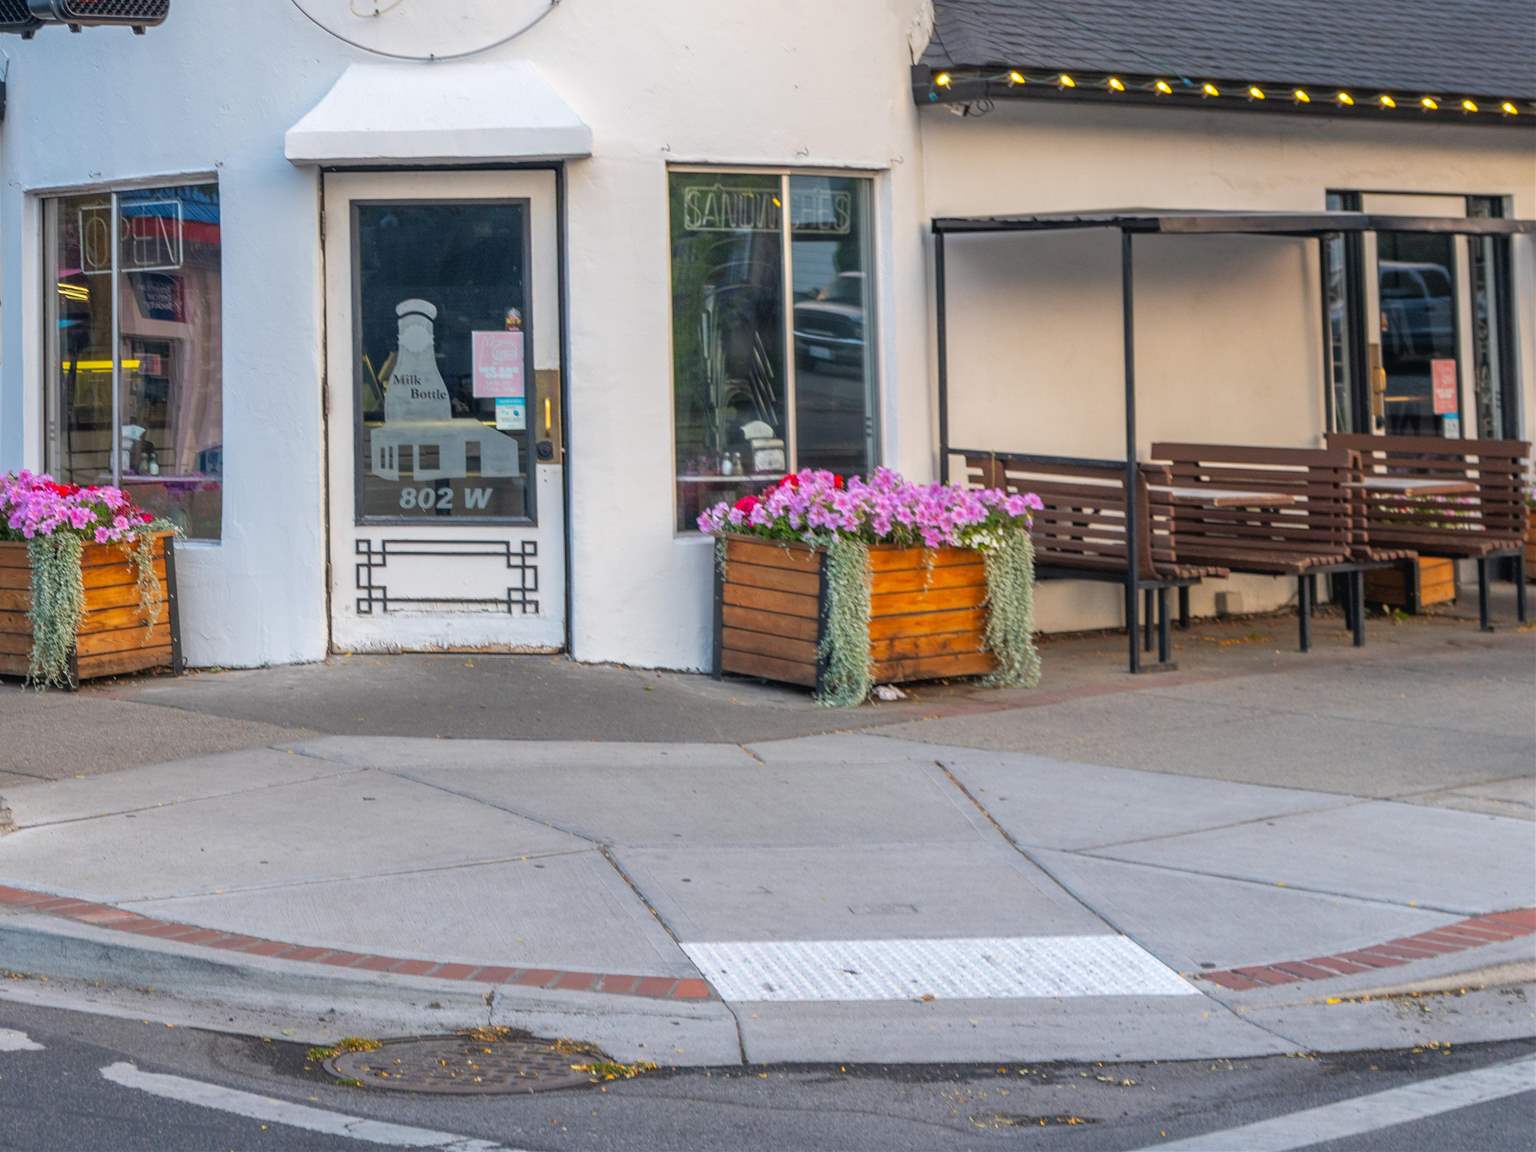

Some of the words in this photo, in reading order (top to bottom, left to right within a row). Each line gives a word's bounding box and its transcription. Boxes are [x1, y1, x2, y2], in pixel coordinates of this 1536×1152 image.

[85, 213, 177, 267] OPEN
[393, 374, 422, 385] Milk
[410, 388, 447, 400] Bottle
[399, 487, 454, 510] 802
[464, 487, 494, 510] W
